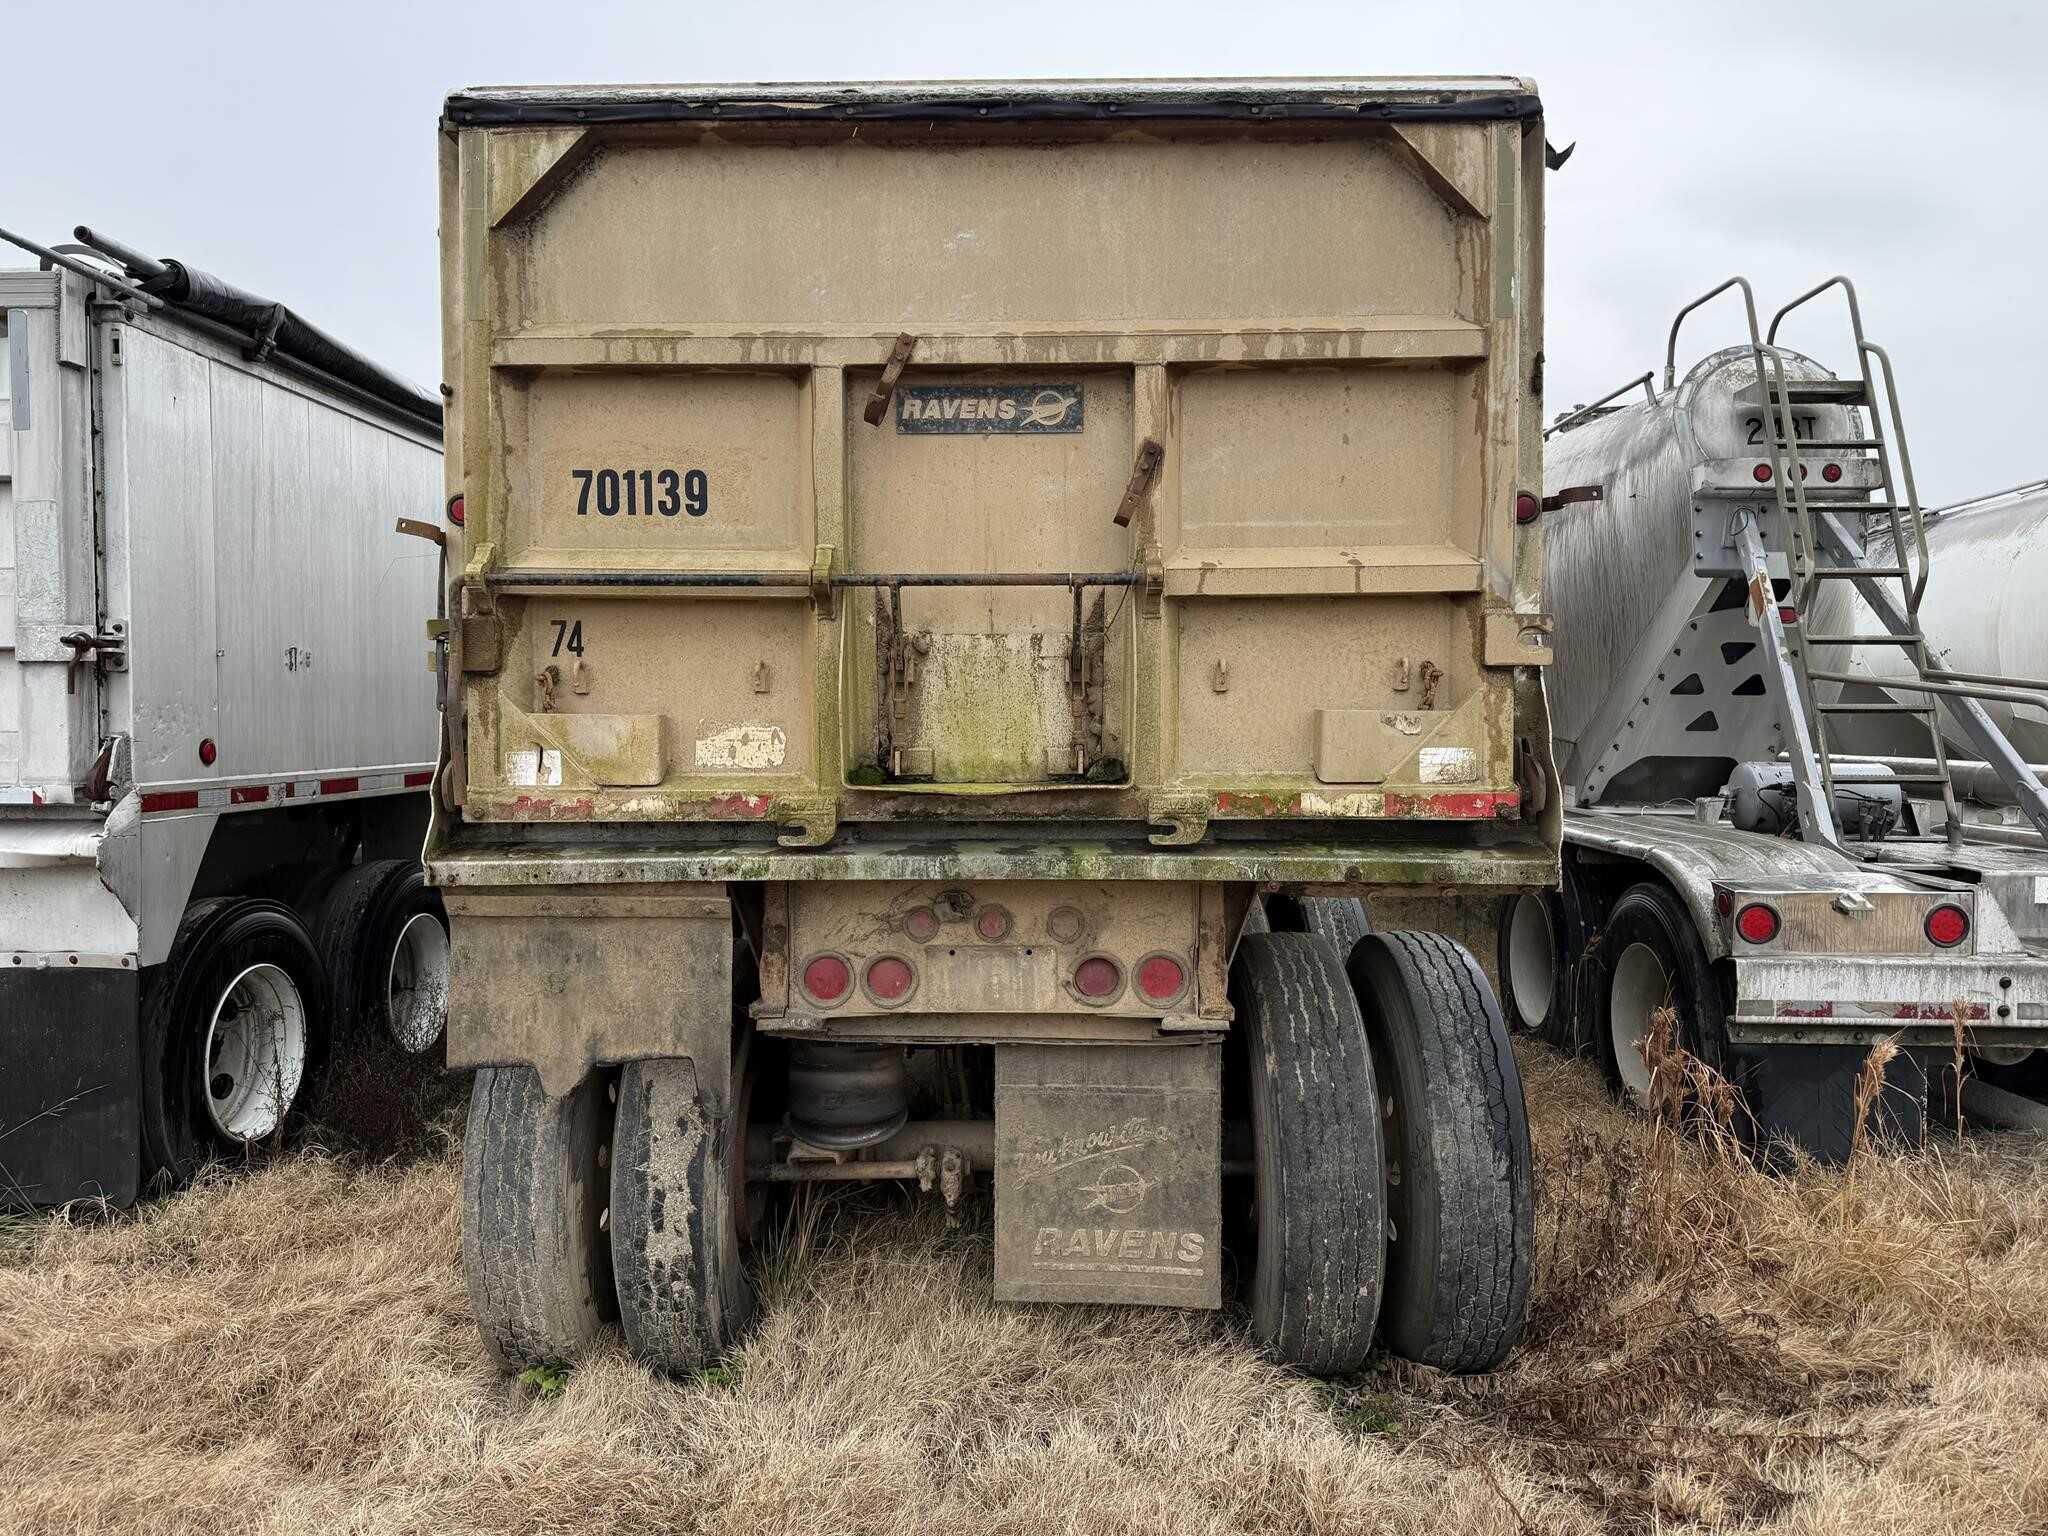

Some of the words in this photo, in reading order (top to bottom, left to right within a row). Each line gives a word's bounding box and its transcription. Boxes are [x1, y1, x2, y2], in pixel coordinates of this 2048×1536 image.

[902, 399, 1017, 419] RAVENS
[572, 469, 708, 516] 701139
[551, 620, 584, 657] 74
[1034, 1227, 1205, 1263] RAVENS
